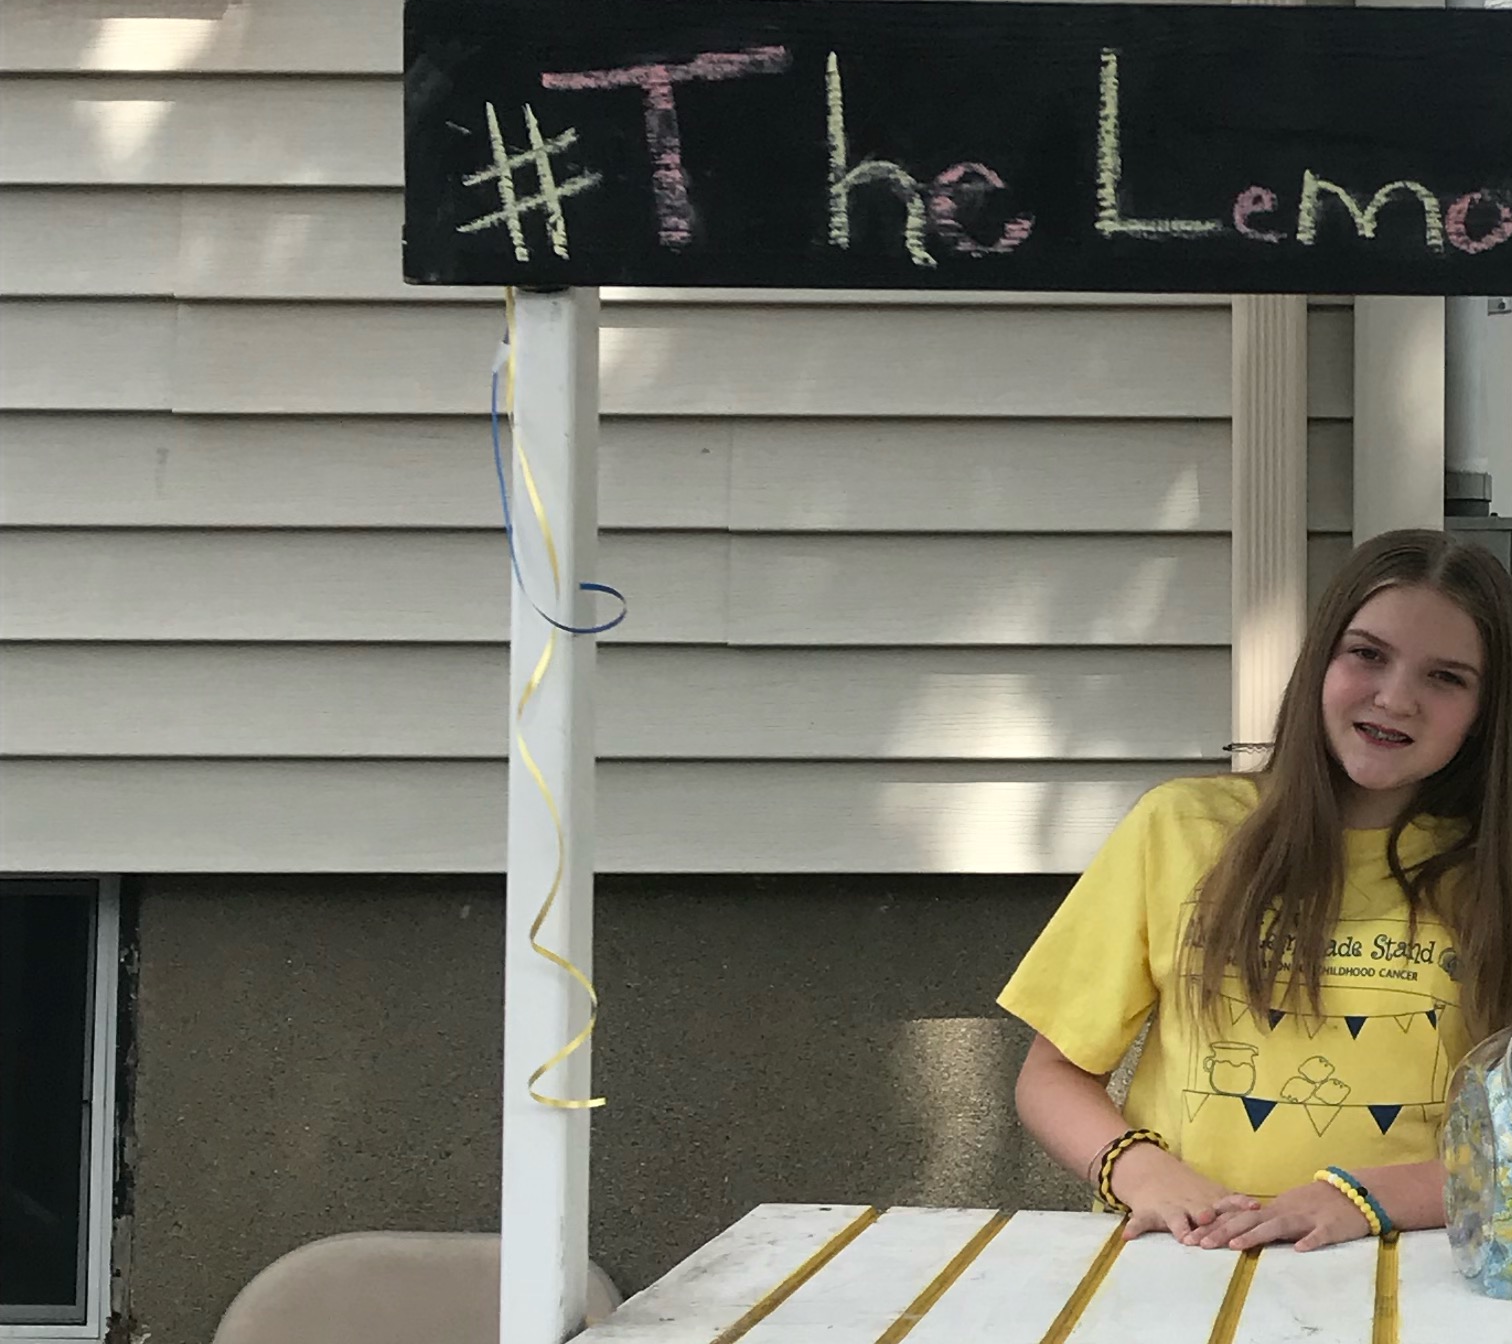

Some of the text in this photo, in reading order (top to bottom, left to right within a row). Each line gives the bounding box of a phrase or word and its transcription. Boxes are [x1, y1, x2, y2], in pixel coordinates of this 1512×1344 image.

[1370, 933, 1436, 964] Stand
[1322, 966, 1418, 981] HILDHOOD CANCER
